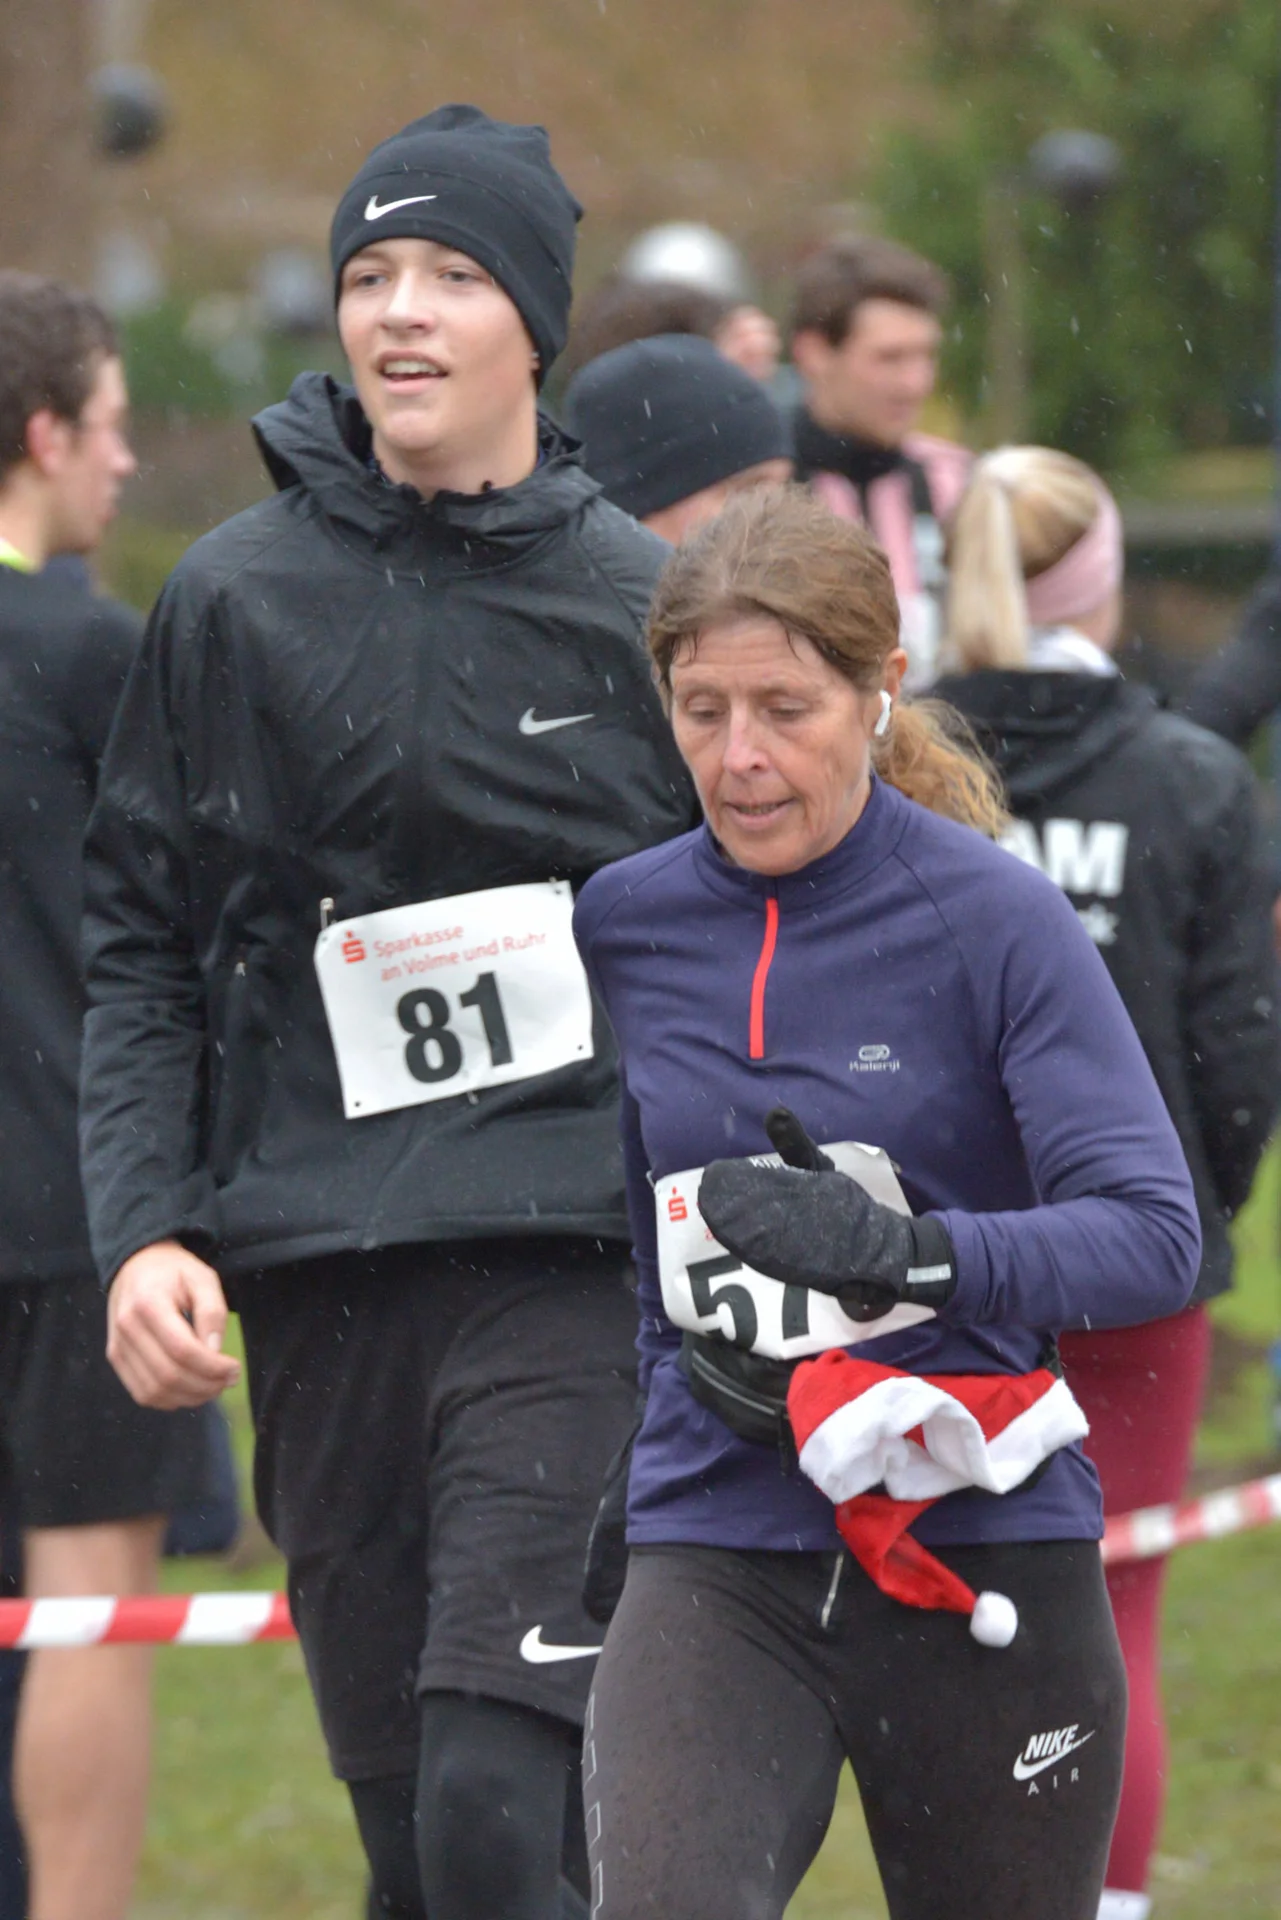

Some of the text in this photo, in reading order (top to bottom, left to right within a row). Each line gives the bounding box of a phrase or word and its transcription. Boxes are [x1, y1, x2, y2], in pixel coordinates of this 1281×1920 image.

[373, 926, 464, 958] Sparkasse
[380, 932, 546, 982] an Volme und Ruhr
[397, 970, 514, 1084] 81
[1024, 1723, 1079, 1761] NIKE
[1028, 1767, 1079, 1796] AIR
